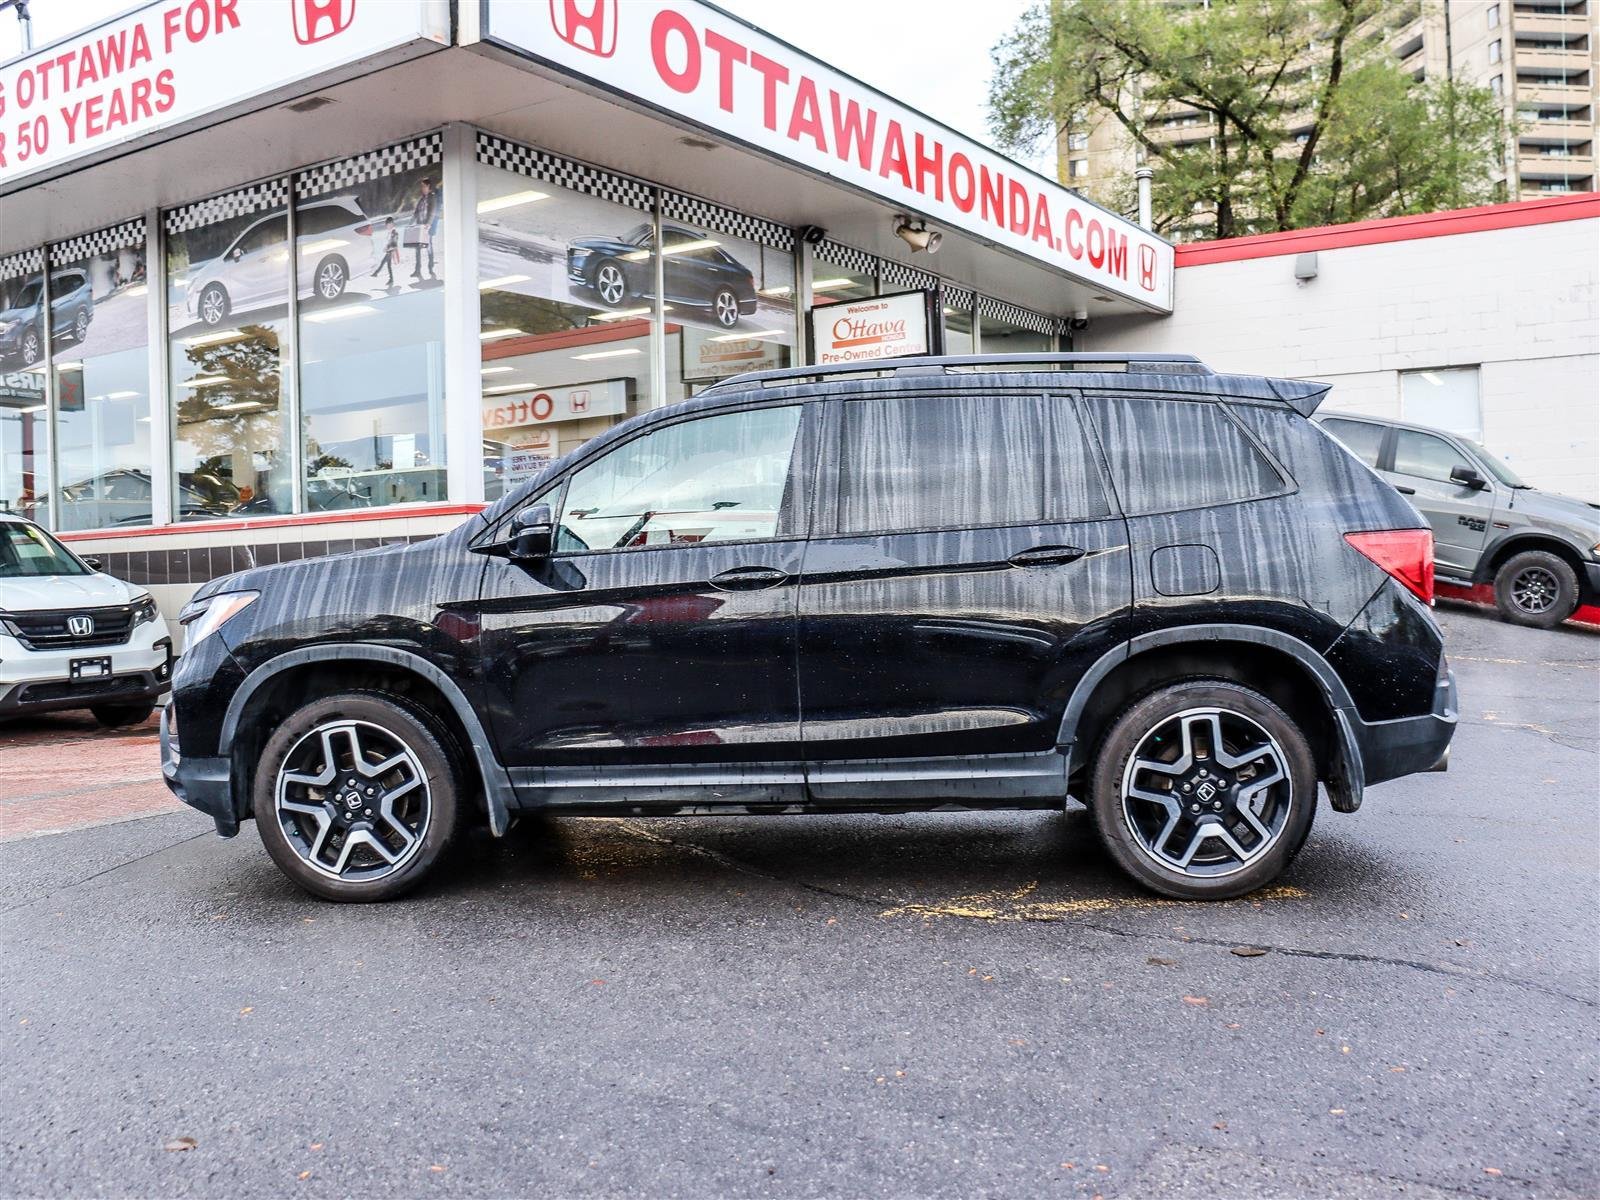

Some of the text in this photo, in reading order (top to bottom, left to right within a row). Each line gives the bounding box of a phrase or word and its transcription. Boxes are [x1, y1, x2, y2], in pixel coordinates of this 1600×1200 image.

[16, 23, 152, 109] OTTAWA
[164, 0, 240, 54] FOR
[17, 115, 49, 162] 50
[60, 68, 175, 145] YEARS
[650, 9, 1128, 282] OTTAWAHONDA.COM
[832, 317, 905, 340] Ottawa
[847, 304, 880, 314] Welcome
[822, 344, 922, 363] Pre-Owned Centre
